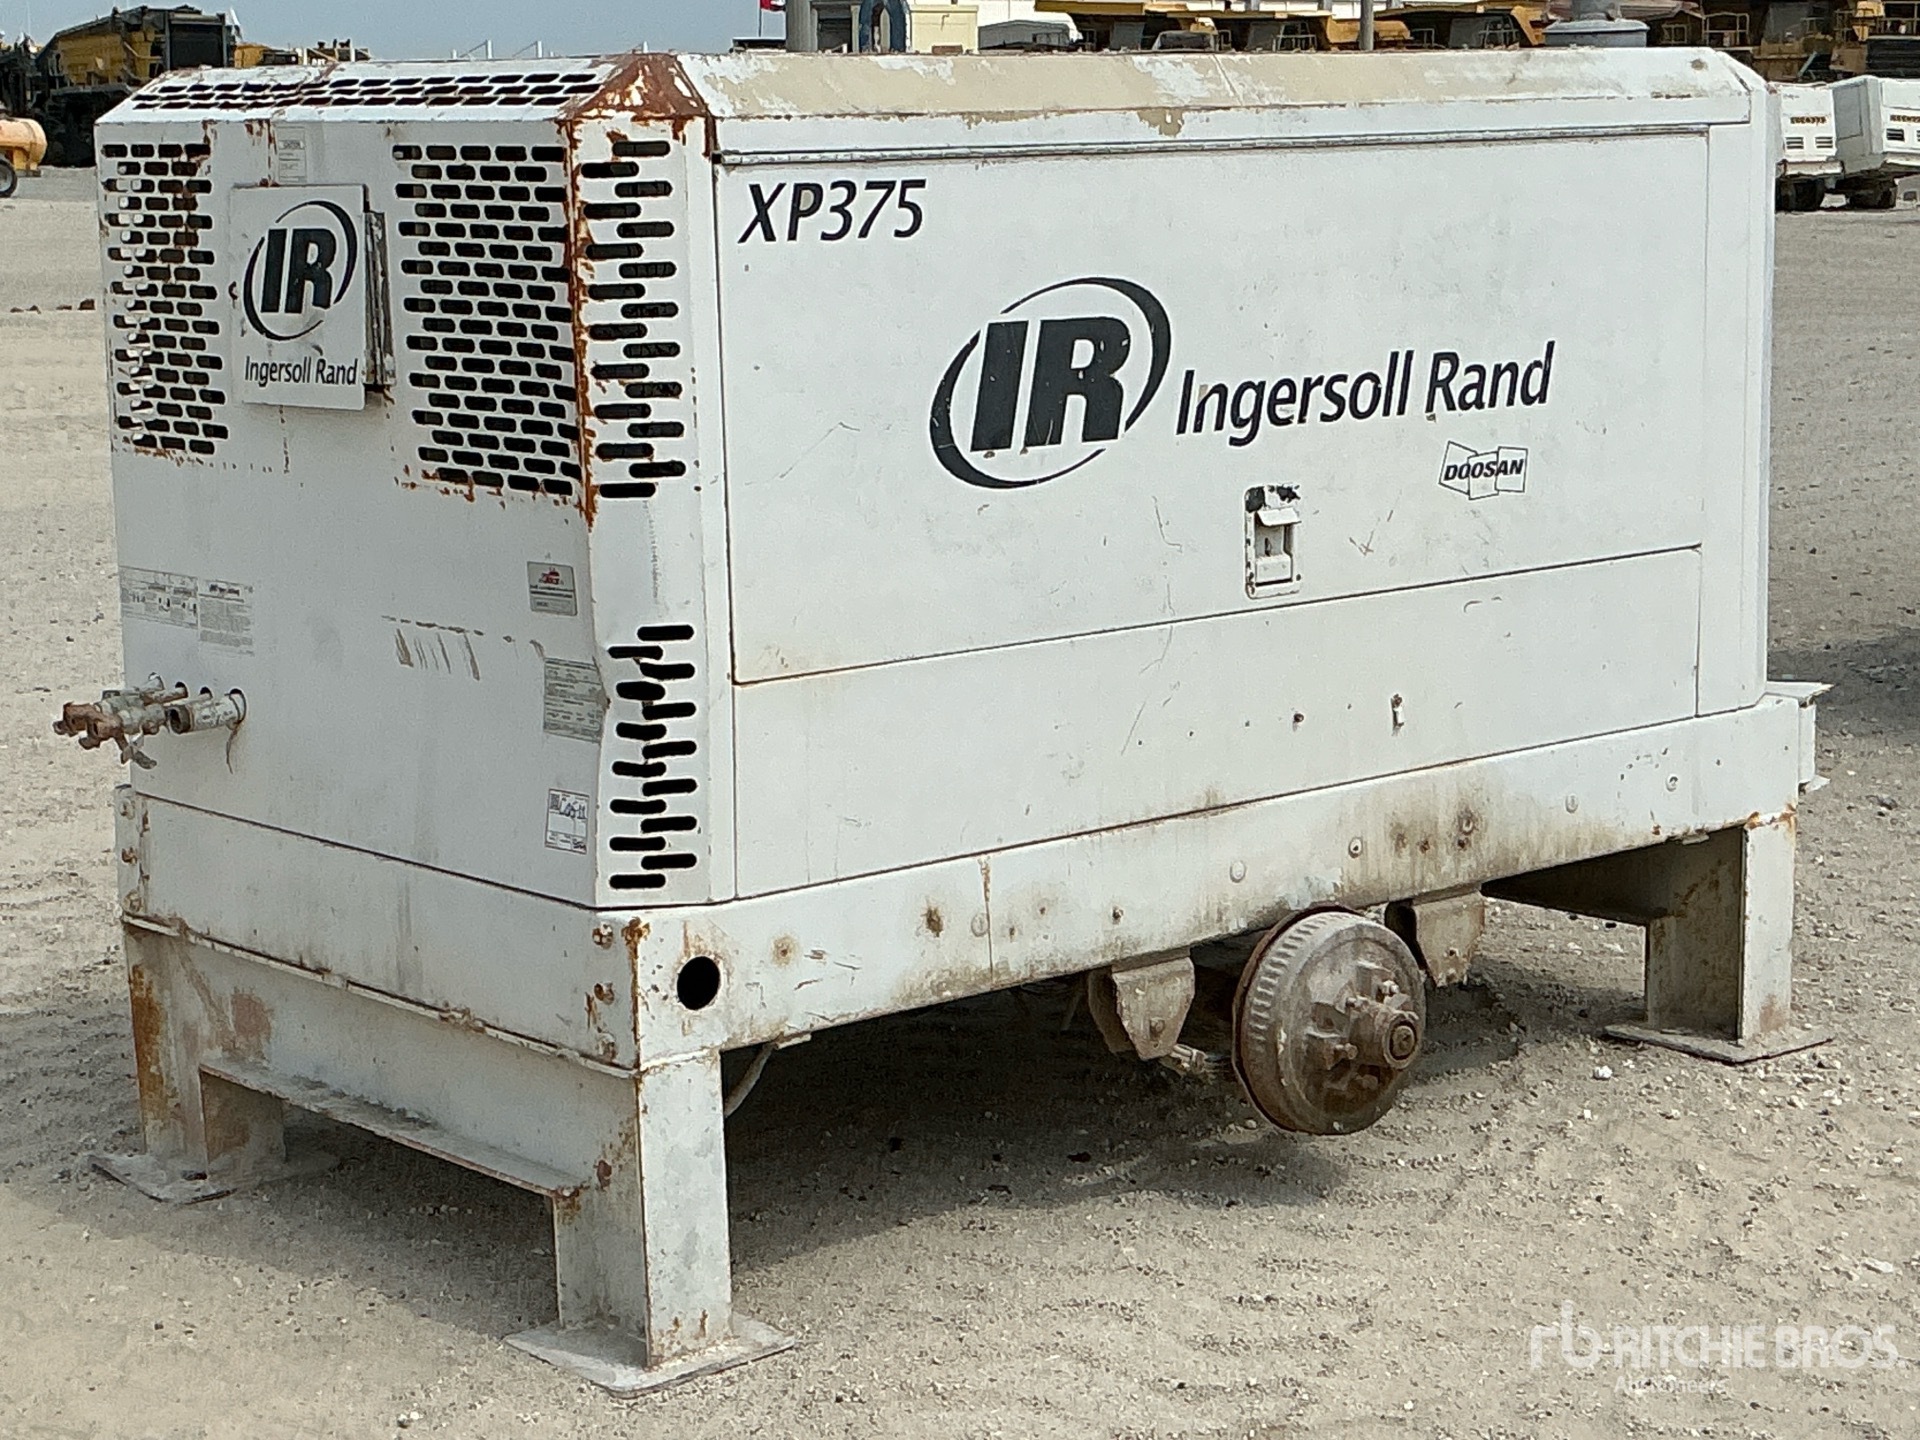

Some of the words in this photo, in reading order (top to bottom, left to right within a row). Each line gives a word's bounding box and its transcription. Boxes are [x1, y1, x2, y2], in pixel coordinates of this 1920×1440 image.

[737, 179, 927, 244] XP375
[260, 228, 337, 315] IR
[244, 356, 312, 388] Ingersoll
[315, 357, 359, 386] Rand
[970, 316, 1132, 452] IR
[1175, 350, 1417, 447] Ingersoll
[1424, 340, 1556, 415] Rand
[1443, 458, 1525, 481] DOOSAN
